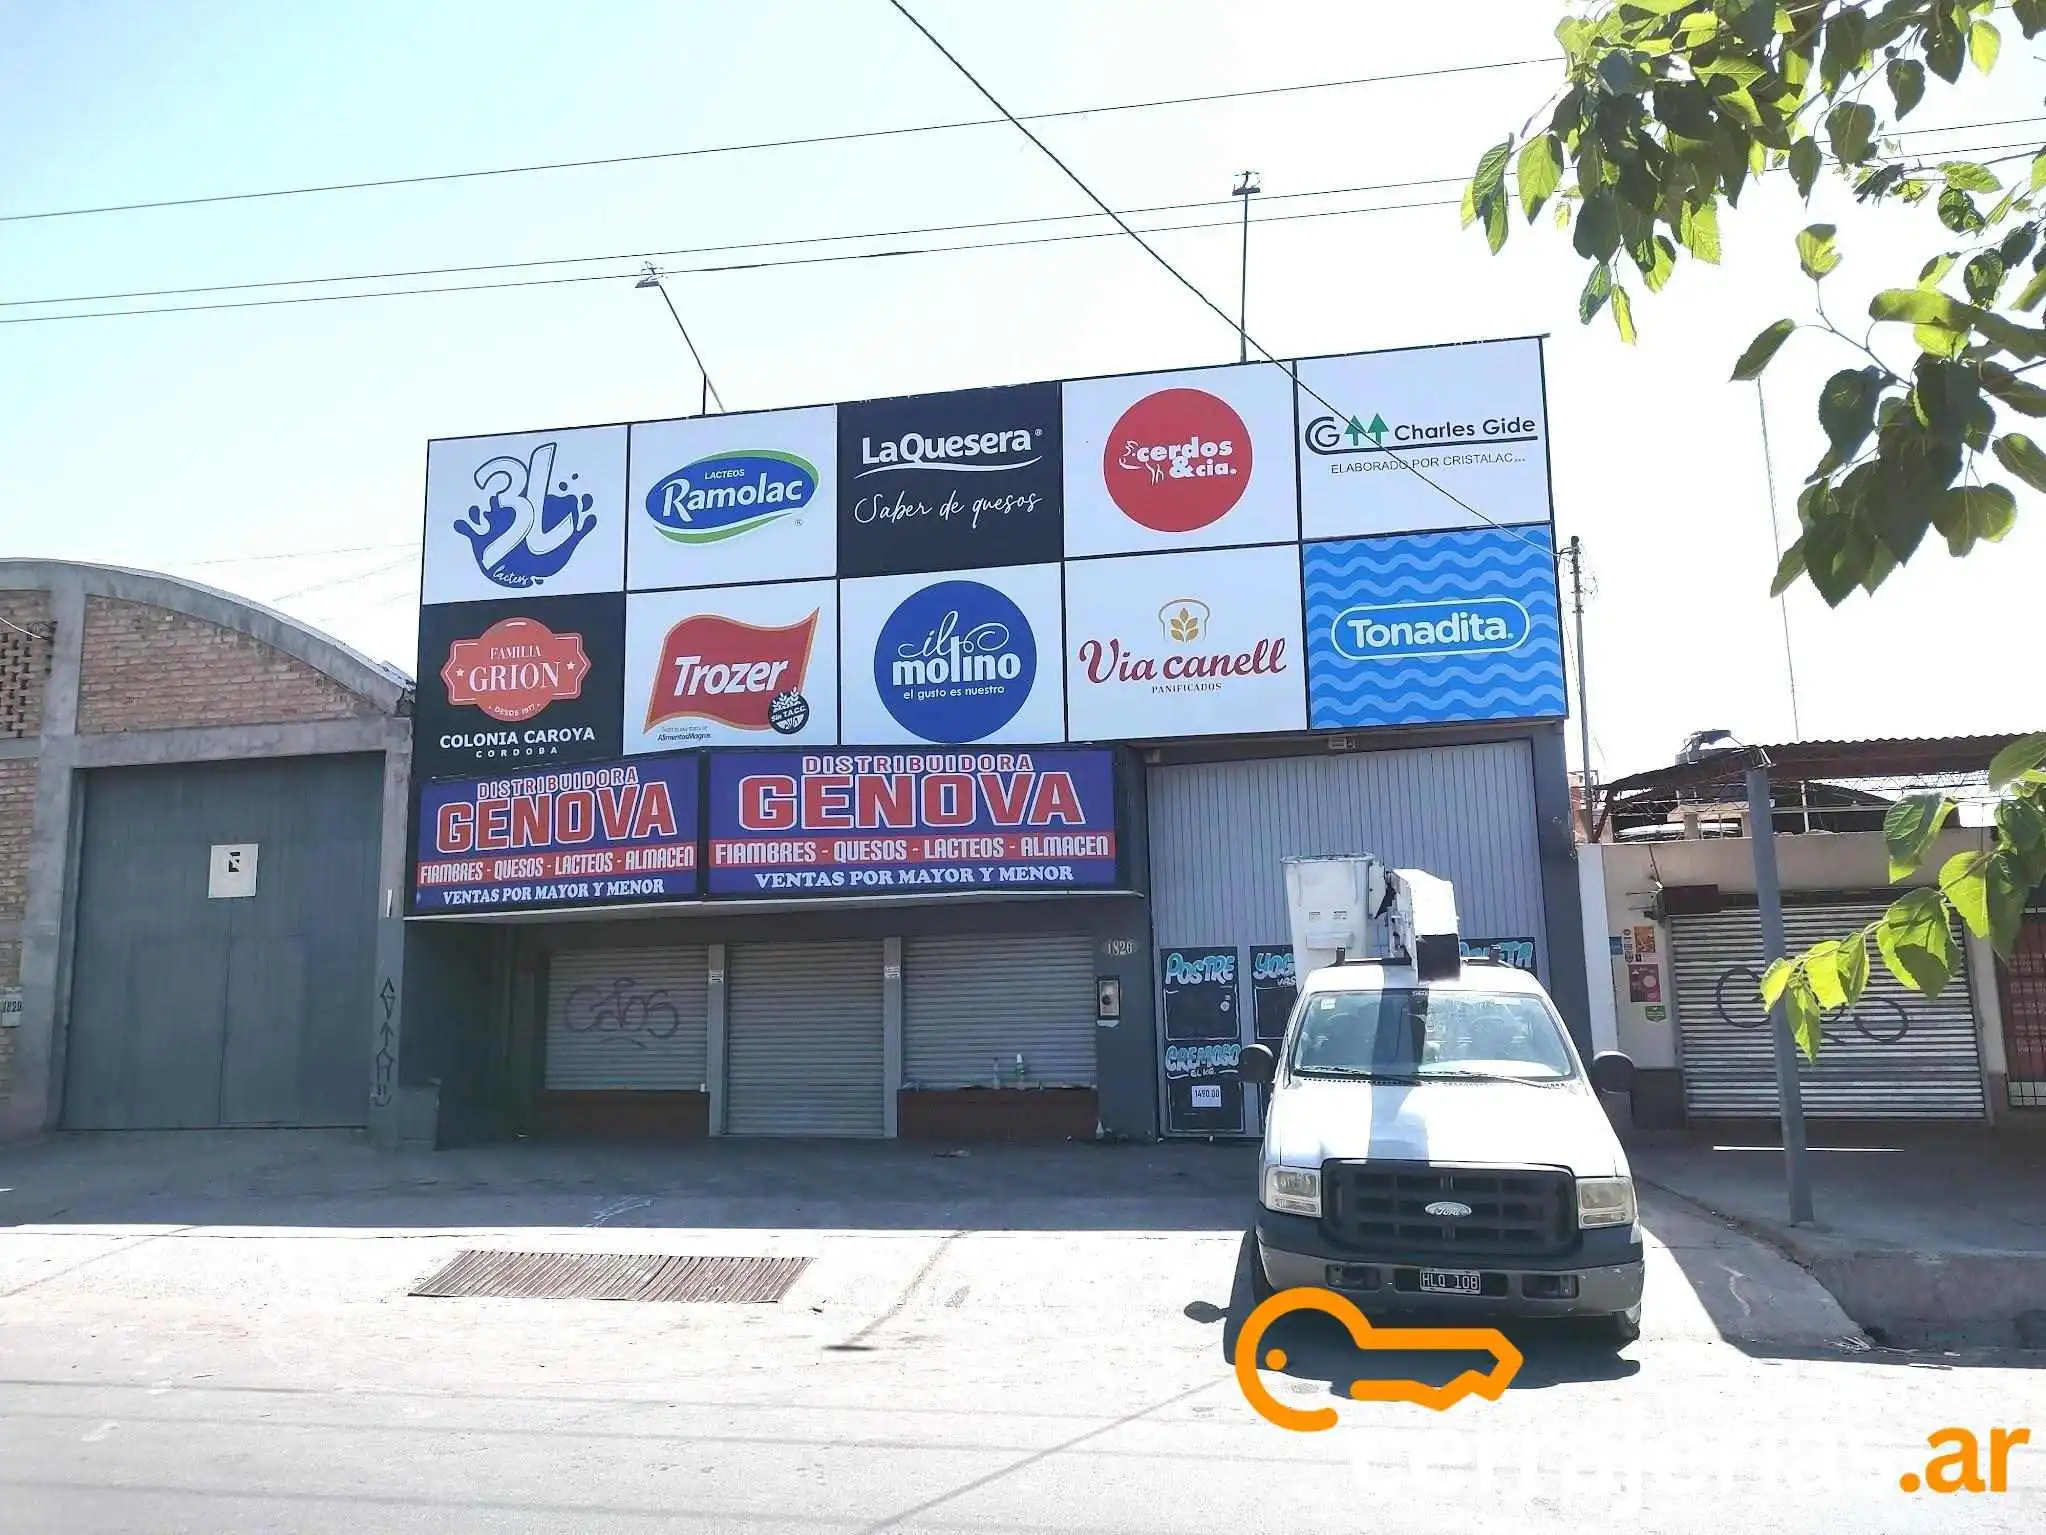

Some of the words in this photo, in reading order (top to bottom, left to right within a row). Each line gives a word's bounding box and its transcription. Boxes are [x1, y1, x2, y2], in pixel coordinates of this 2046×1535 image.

[1395, 421, 1474, 442] Charles
[1482, 416, 1536, 436] Gide
[1138, 436, 1233, 462] cerdos
[704, 468, 745, 481] LACTEOS
[1331, 459, 1408, 474] ELABORADO
[1412, 457, 1439, 469] POR
[663, 474, 803, 524] Ramolac
[854, 490, 932, 523] Saber
[940, 490, 965, 515] de
[972, 490, 1043, 528] quesos
[490, 645, 542, 660] FAMILIA
[892, 635, 1021, 686] molino
[1079, 639, 1155, 684] Via
[1163, 636, 1287, 677] canell
[469, 661, 561, 692] GRION
[674, 655, 788, 696] Trozer
[1152, 683, 1222, 694] PANIFICADOS
[903, 689, 914, 700] el
[917, 688, 946, 701] gusto
[950, 688, 962, 697] es
[440, 732, 518, 748] COLONIA
[524, 727, 595, 744] CAROYA
[802, 753, 1035, 775] DISTRIBUIDORA
[477, 766, 639, 800] DISTRIBUIDORA
[738, 771, 1087, 830] GENOVA
[437, 782, 678, 853] GENOVA
[715, 841, 816, 865] FIAMBRES
[833, 839, 907, 862] QUESOS
[924, 837, 1004, 859] LACTEOS
[1020, 835, 1108, 858] ALMACEN
[420, 861, 483, 884] FIAMBRES
[494, 857, 544, 881] QUESOS
[555, 853, 613, 876] LACTEOS
[625, 846, 694, 871] ALMACEN
[754, 871, 846, 889] VENTAS
[850, 870, 894, 886] POR
[898, 868, 974, 885] MAYOR
[980, 867, 996, 883] Y
[999, 865, 1074, 883] MENOR
[443, 887, 500, 905] VENTAS
[502, 886, 532, 902] POR
[535, 883, 590, 900] MAYOR
[592, 882, 606, 896] Y
[607, 878, 665, 895] MENOR
[1165, 953, 1236, 985] POSTRE
[1253, 953, 1295, 980] YOG
[1435, 1206, 1462, 1217] Ford
[1422, 1272, 1447, 1289] HLQ
[1455, 1274, 1478, 1290] 108
